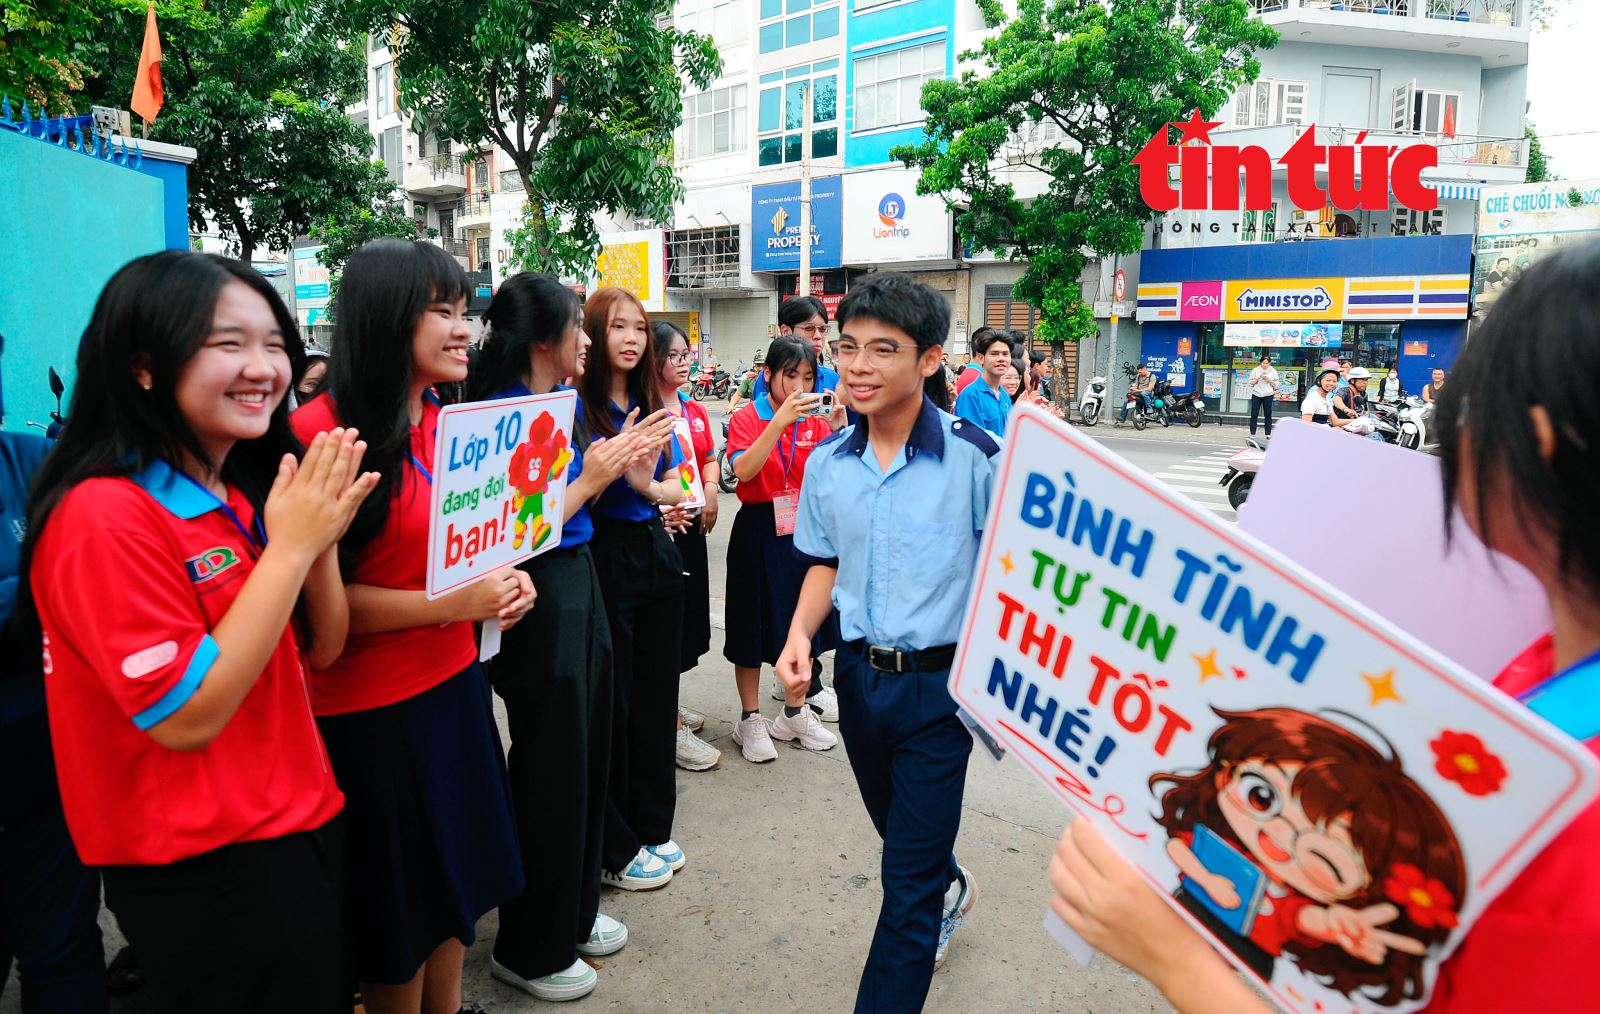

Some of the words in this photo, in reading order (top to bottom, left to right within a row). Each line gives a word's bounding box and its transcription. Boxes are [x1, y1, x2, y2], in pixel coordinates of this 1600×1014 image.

[1486, 192, 1510, 214] CHÈ
[1513, 185, 1552, 211] CHUỐI
[767, 234, 821, 249] PROPETY
[873, 226, 910, 239] Liontrip
[1245, 294, 1325, 308] MINISTOP
[449, 433, 489, 472] Lớp
[494, 410, 522, 455] 10
[442, 486, 479, 516] đang
[484, 471, 506, 502] đợi
[444, 499, 509, 570] bạn!
[1019, 470, 1154, 579] BÌNH
[1173, 552, 1326, 684] TĨNH
[1030, 549, 1096, 615] TỰ
[1101, 586, 1177, 663] TIN
[996, 591, 1073, 679] THI
[1089, 653, 1193, 757] TỐT
[986, 656, 1116, 779] NHÉ!
